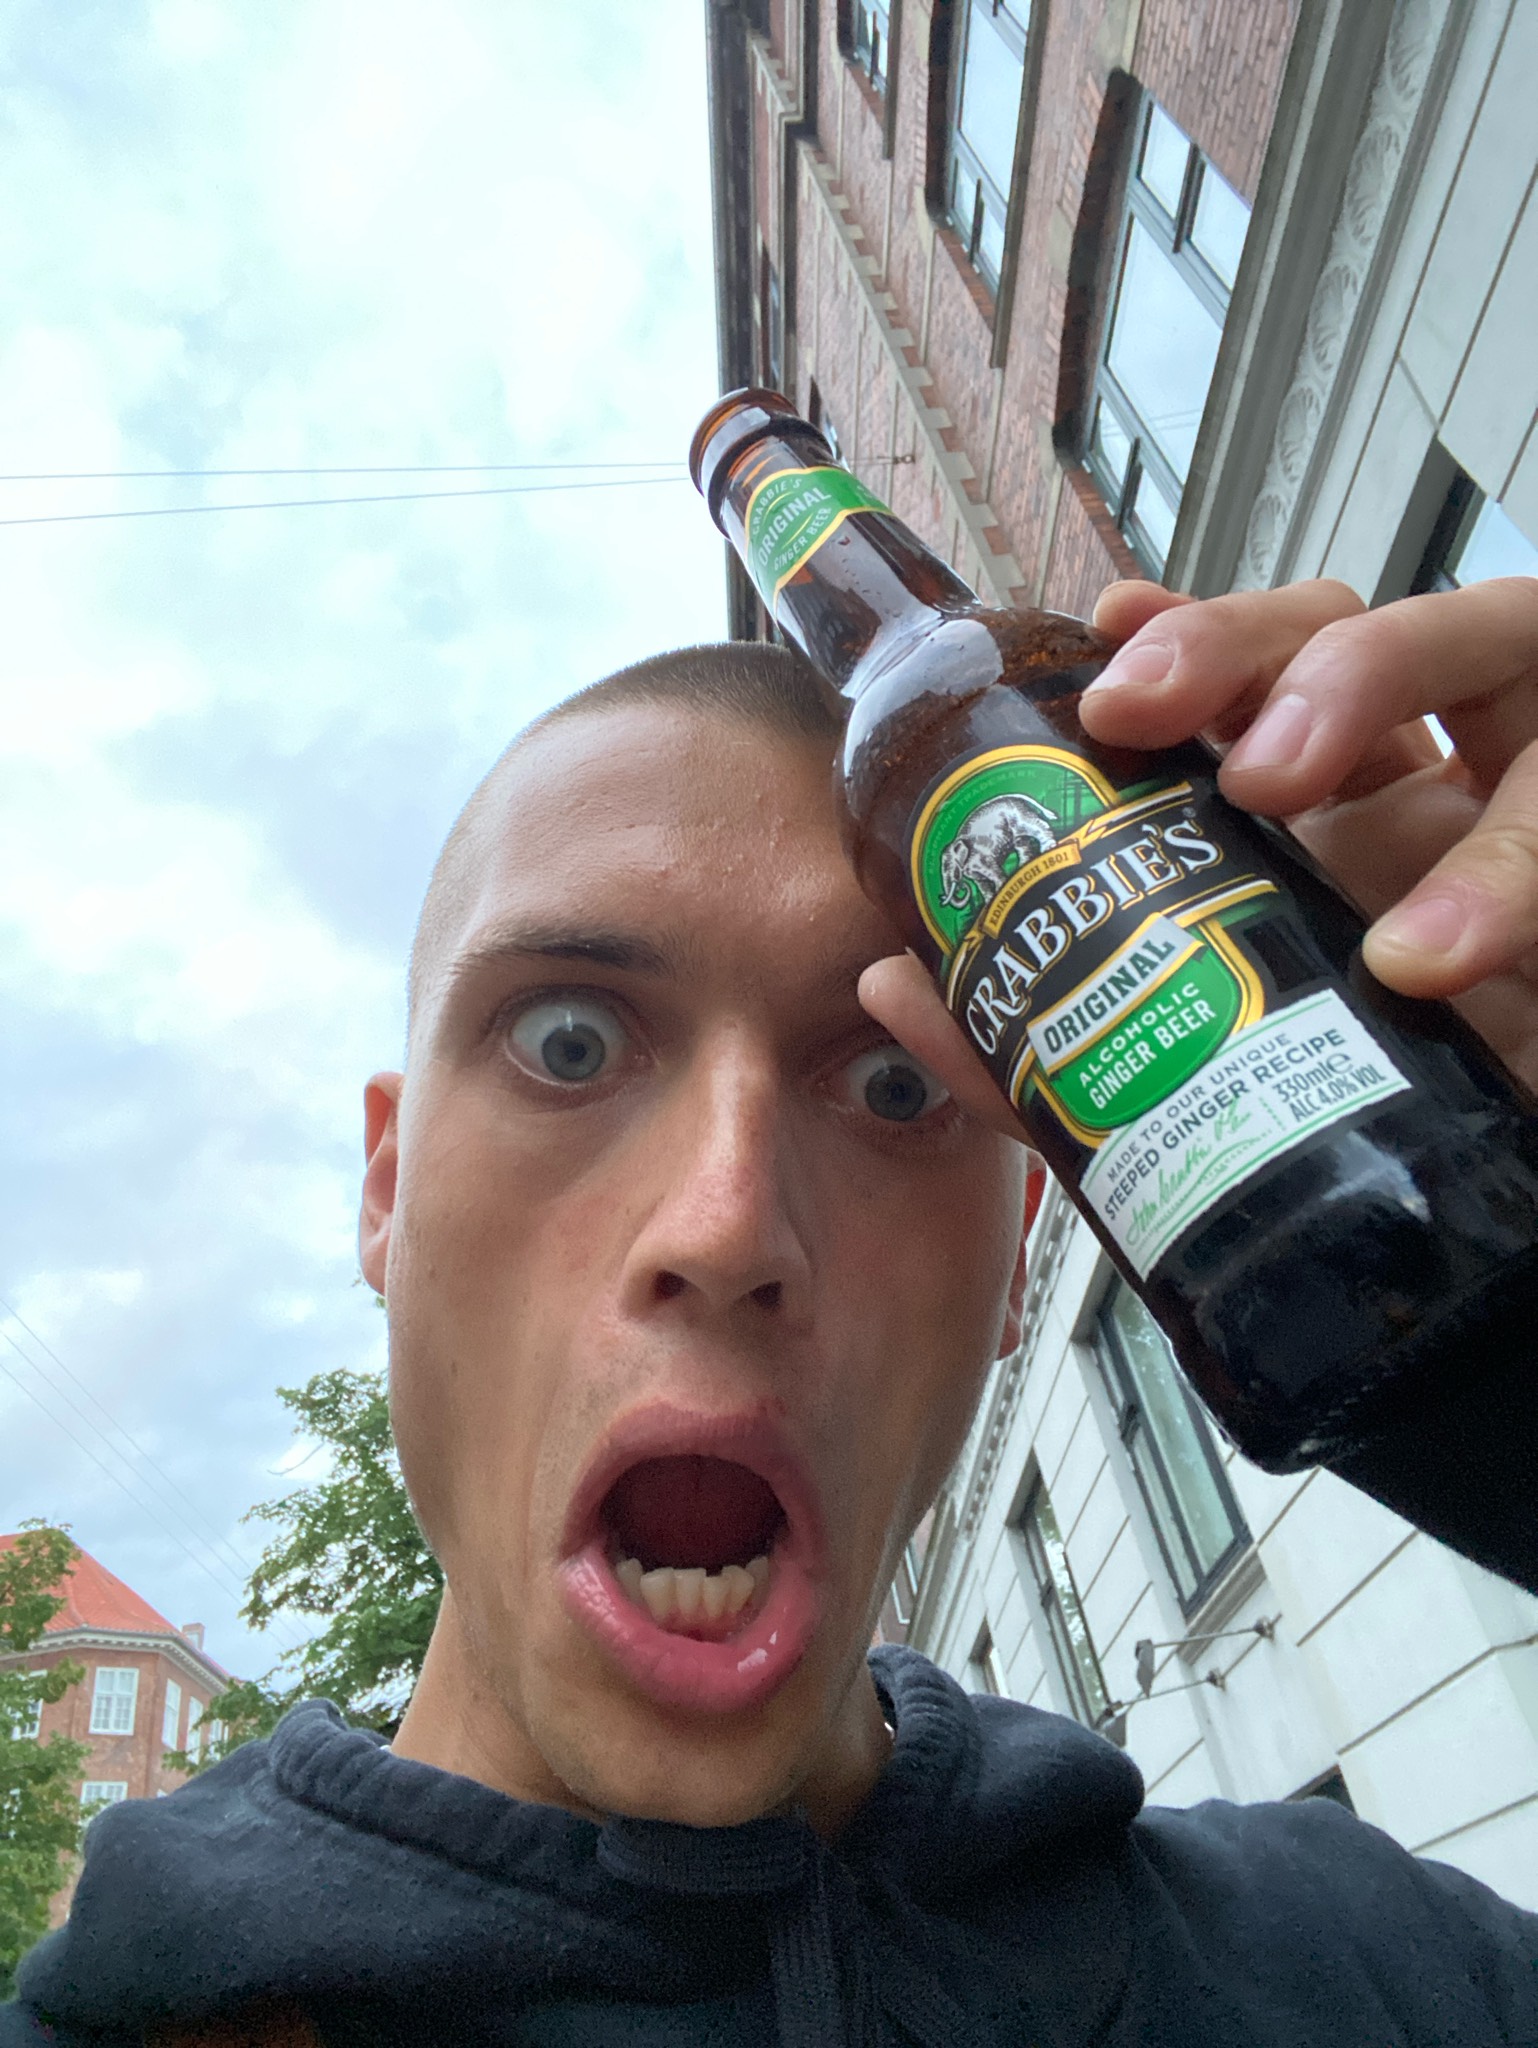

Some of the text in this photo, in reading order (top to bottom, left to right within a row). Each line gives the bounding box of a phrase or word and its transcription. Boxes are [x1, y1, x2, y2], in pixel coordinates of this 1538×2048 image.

[752, 478, 802, 535] CRABBIE'S
[758, 487, 832, 567] ORIGINAL
[774, 507, 832, 571] GINGER BEER
[966, 820, 1222, 1056] CRABBIE'S
[989, 852, 1069, 926] EDINBURGH 1801
[1043, 939, 1176, 1054] ORIGINAL
[1079, 982, 1199, 1088] ALCOHOLIC
[1088, 999, 1217, 1110] GINGER BEER
[1107, 1142, 1140, 1182] MADE
[1140, 1120, 1162, 1143] TO
[1167, 1086, 1205, 1118] OUR
[1210, 1033, 1291, 1085] UNIQUE
[1289, 1063, 1387, 1122] ALC 4.0% VOL
[1104, 1149, 1160, 1220] STEEPED
[1162, 1080, 1250, 1150] GINGER
[1252, 1028, 1346, 1084] RECIPE
